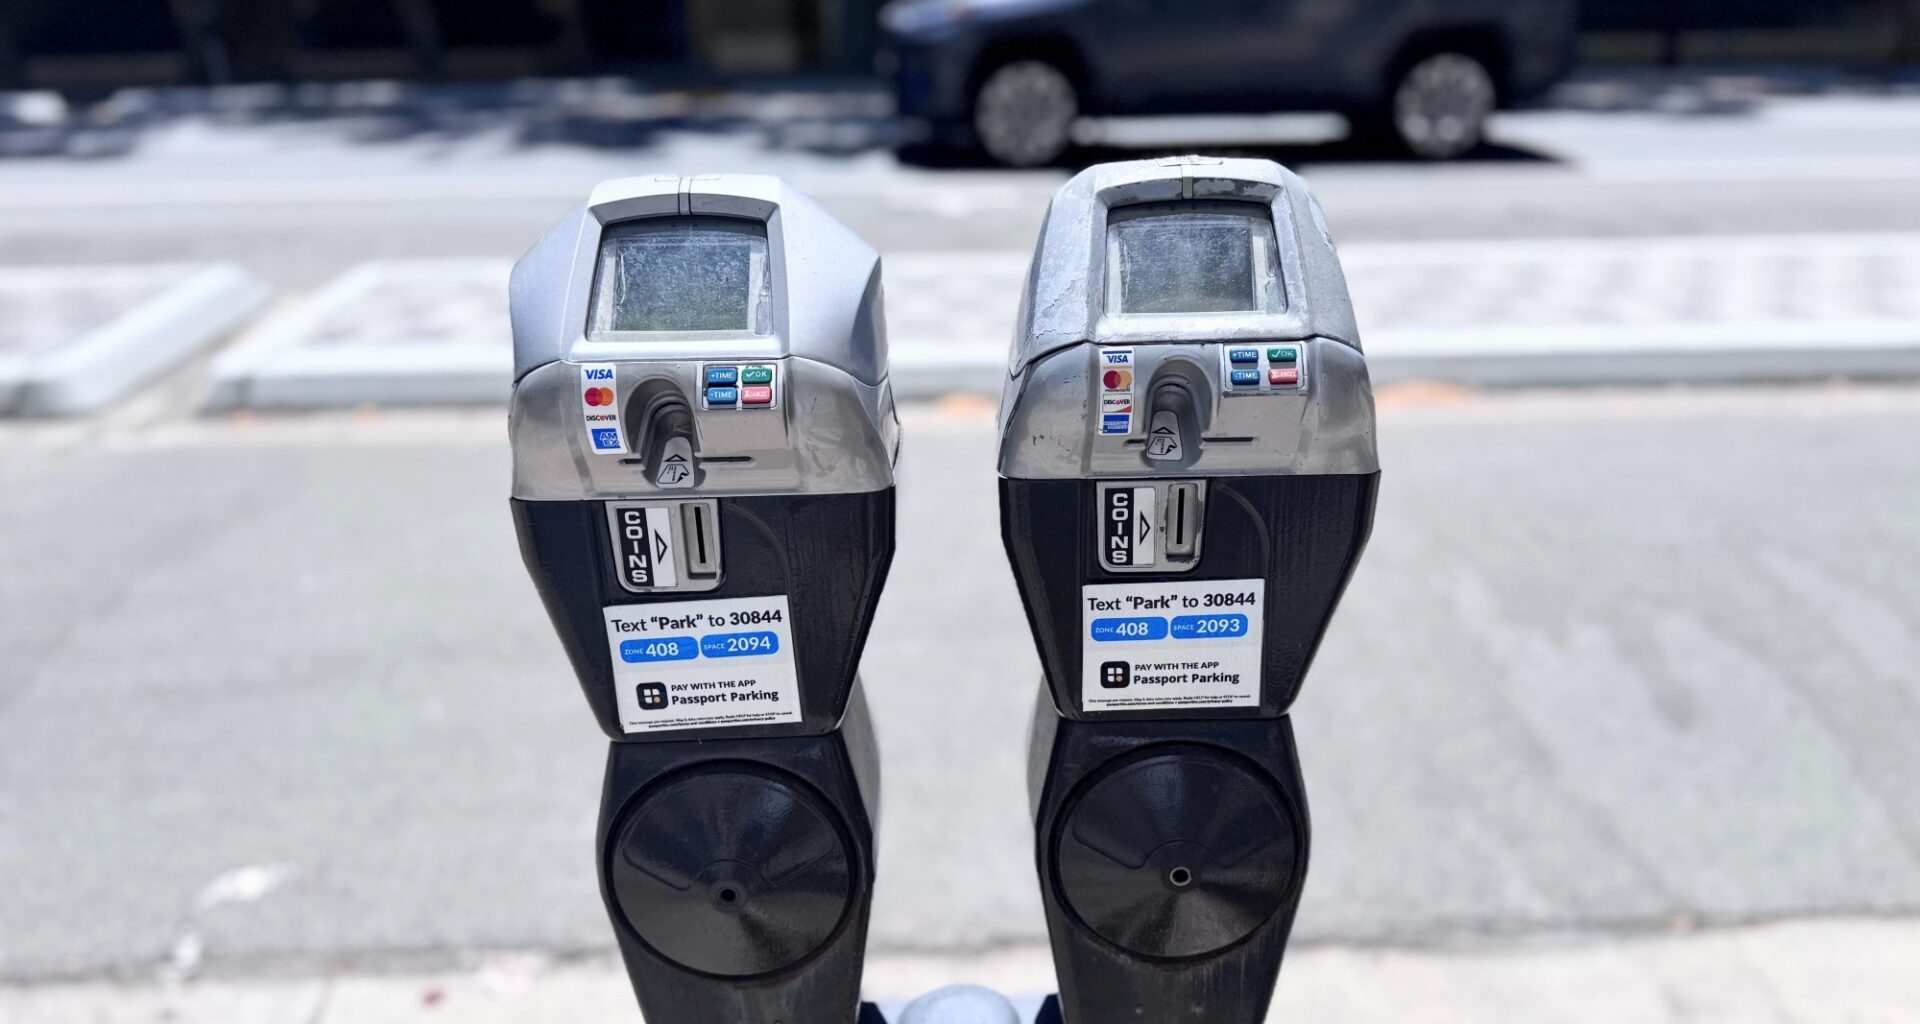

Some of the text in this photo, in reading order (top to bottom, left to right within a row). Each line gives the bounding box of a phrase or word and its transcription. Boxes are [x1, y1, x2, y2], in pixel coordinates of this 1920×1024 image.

[1107, 355, 1129, 364] VISA
[585, 369, 613, 380] VISA
[755, 370, 767, 378] OK
[1111, 493, 1129, 563] COINS
[624, 511, 648, 583] COINS
[1087, 597, 1121, 611] Text
[1182, 597, 1199, 608] to
[1203, 592, 1256, 608] 30844
[611, 618, 648, 633] Text
[708, 615, 726, 627] to
[729, 609, 782, 626] 30844
[1196, 618, 1241, 634] 2093
[1116, 622, 1149, 636] 408
[624, 642, 679, 657] ZONE 408
[727, 636, 771, 652] 2094
[1135, 663, 1152, 671] PAY
[1181, 662, 1199, 670] THE
[1200, 661, 1219, 669] APP
[671, 679, 756, 692] PAY WITH THE APP
[1133, 673, 1240, 686] Passport Parking
[671, 690, 779, 706] Passport Parking
